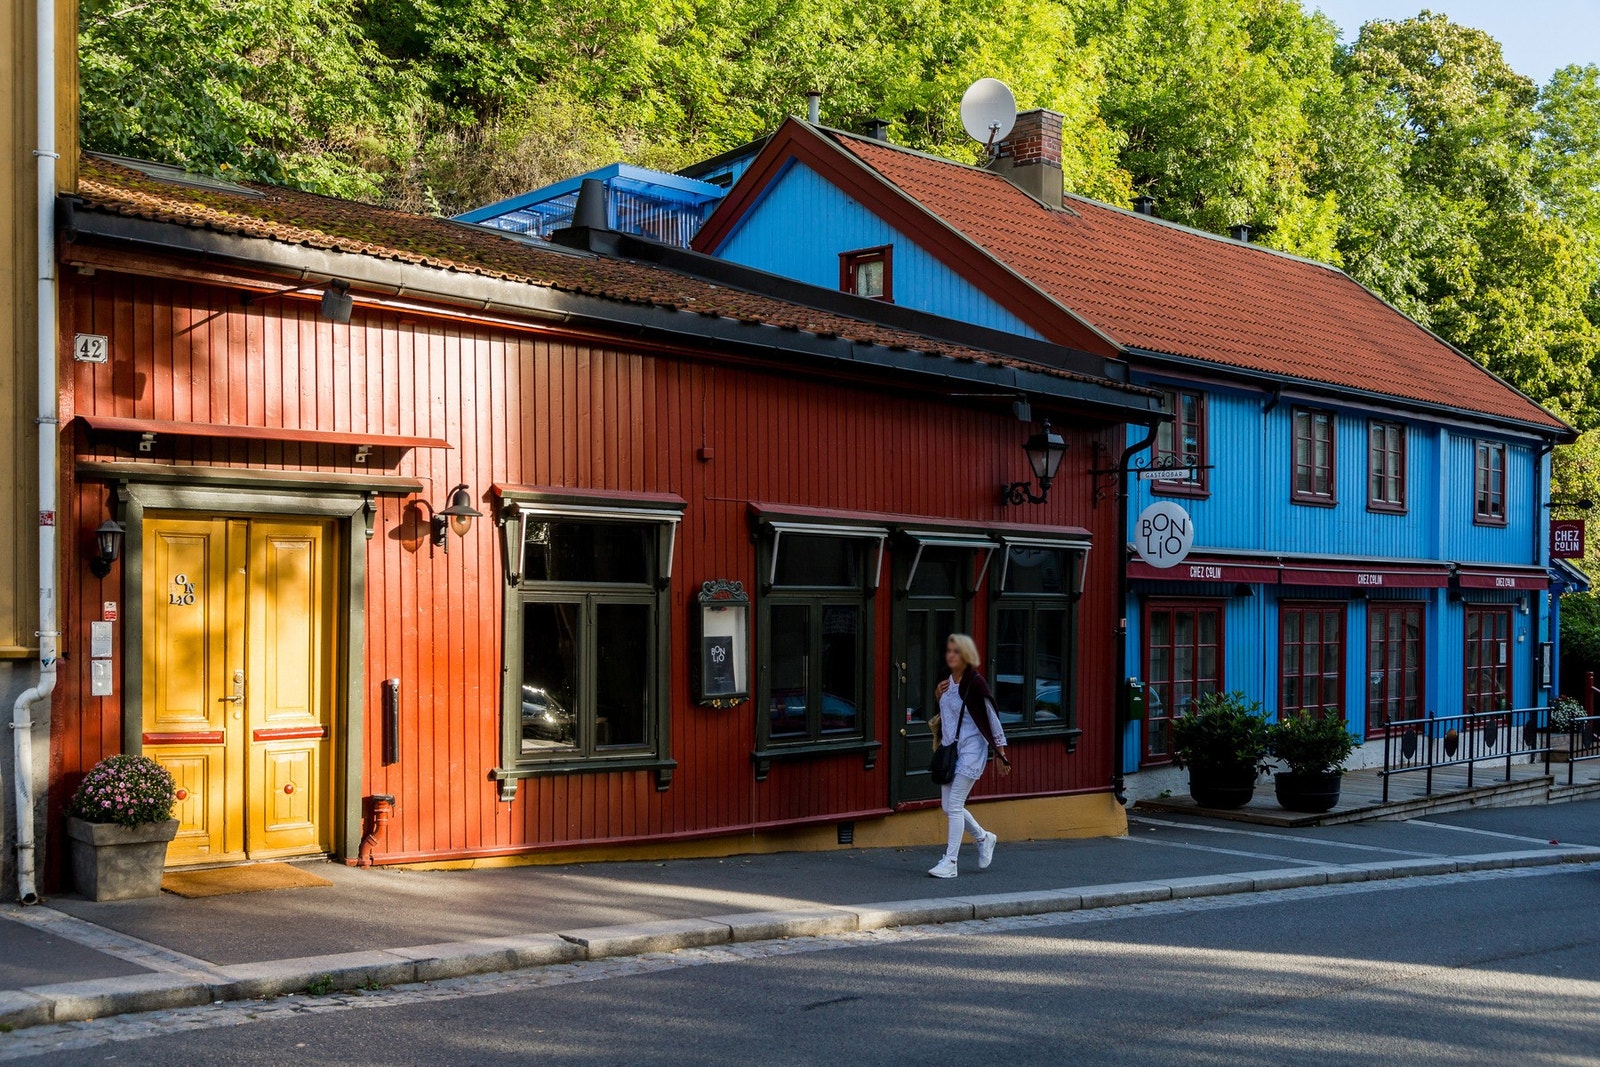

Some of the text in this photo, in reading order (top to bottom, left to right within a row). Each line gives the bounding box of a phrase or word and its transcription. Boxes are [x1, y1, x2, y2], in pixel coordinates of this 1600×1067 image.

[80, 339, 101, 358] 42
[1145, 471, 1183, 479] GASTROBAR
[1143, 513, 1186, 537] BON
[1555, 530, 1579, 541] CHEZ
[1190, 565, 1204, 578] CHEZ
[711, 645, 726, 655] BON
